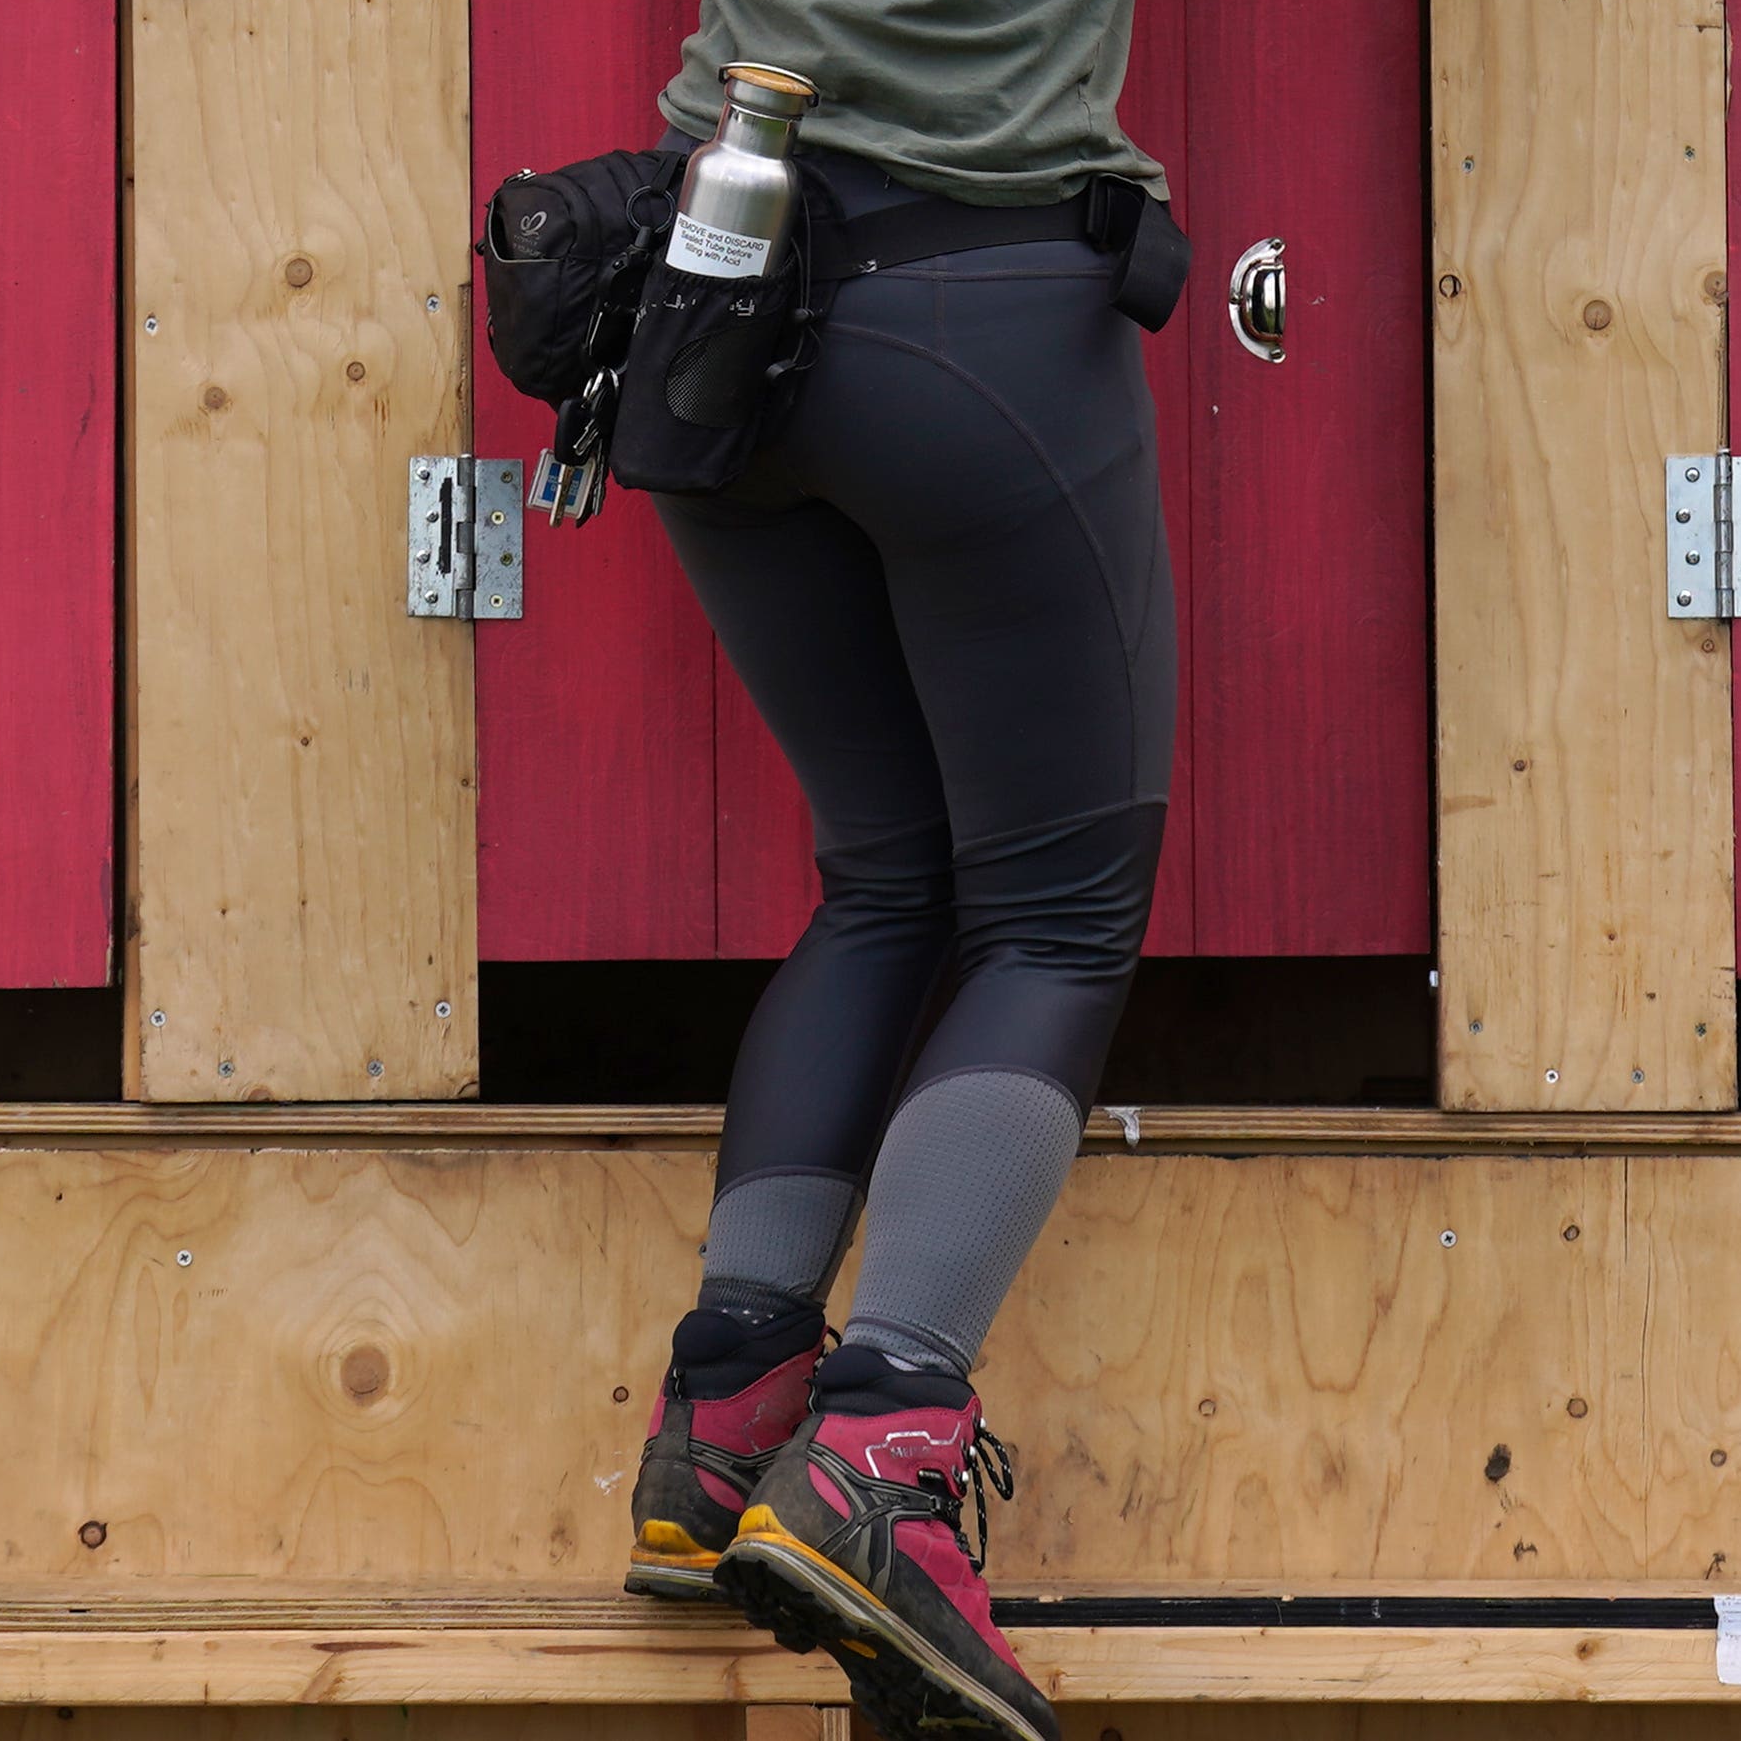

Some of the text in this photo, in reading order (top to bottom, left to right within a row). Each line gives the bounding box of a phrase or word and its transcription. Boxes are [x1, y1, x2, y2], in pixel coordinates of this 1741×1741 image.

[678, 217, 764, 252] REMOVE and DISCARD
[704, 249, 721, 262] with
[705, 238, 726, 253] Tube
[726, 245, 753, 259] before
